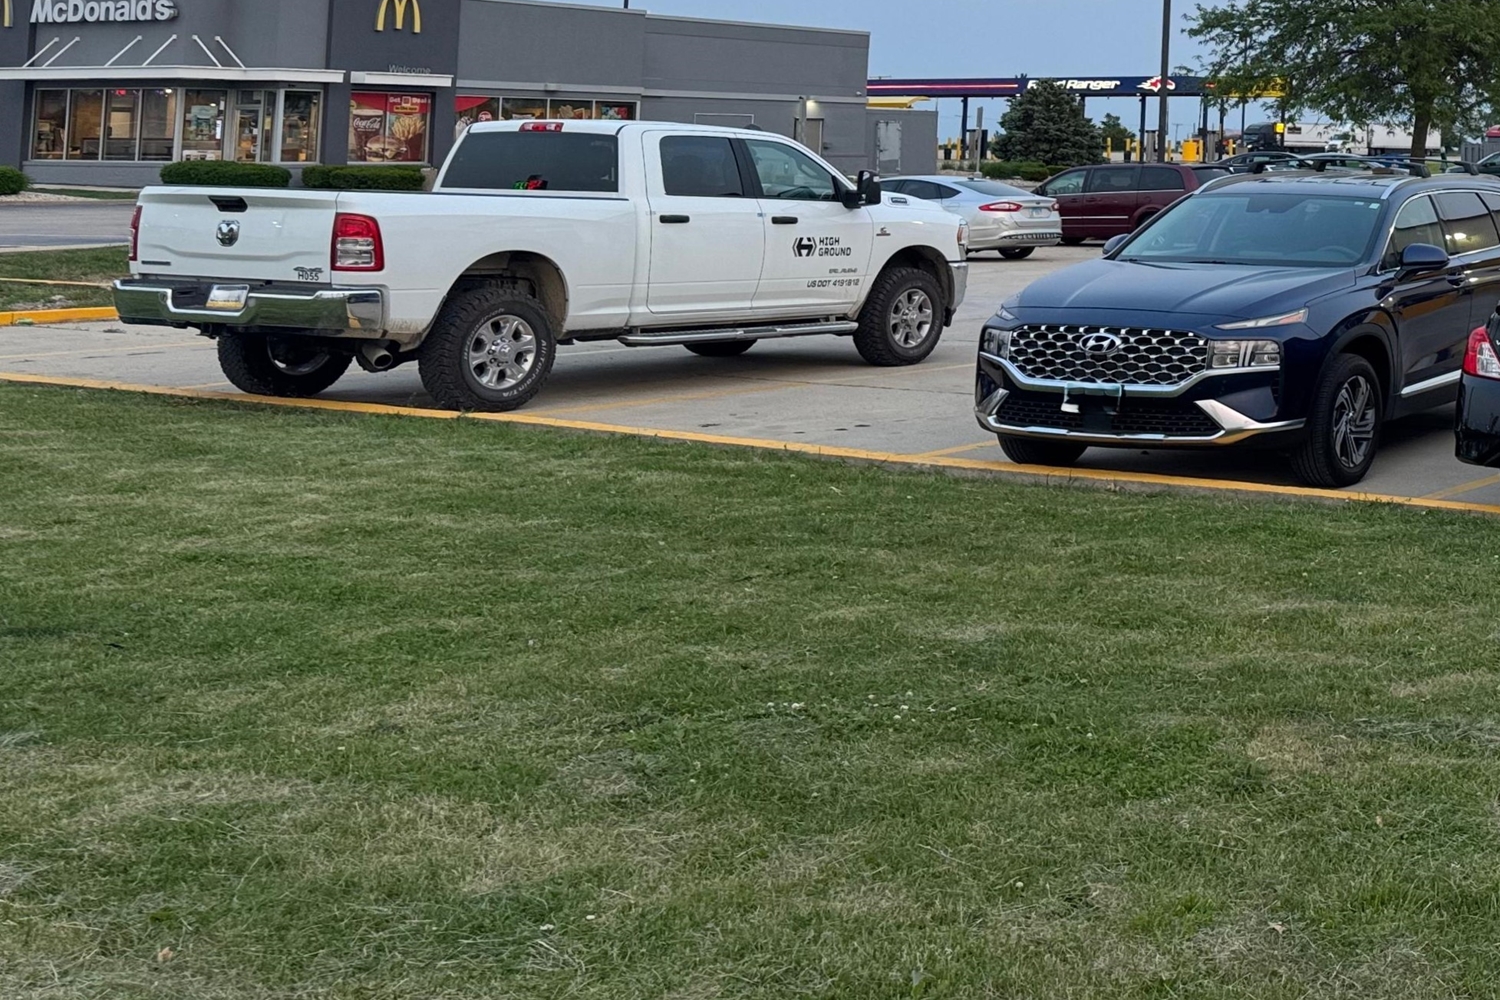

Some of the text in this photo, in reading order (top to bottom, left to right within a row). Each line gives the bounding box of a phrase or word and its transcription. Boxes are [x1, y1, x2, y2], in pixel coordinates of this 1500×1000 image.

[388, 64, 432, 75] Welcome
[1066, 79, 1121, 91] Ranger
[818, 236, 841, 246] HIGH
[817, 246, 853, 257] GROUND
